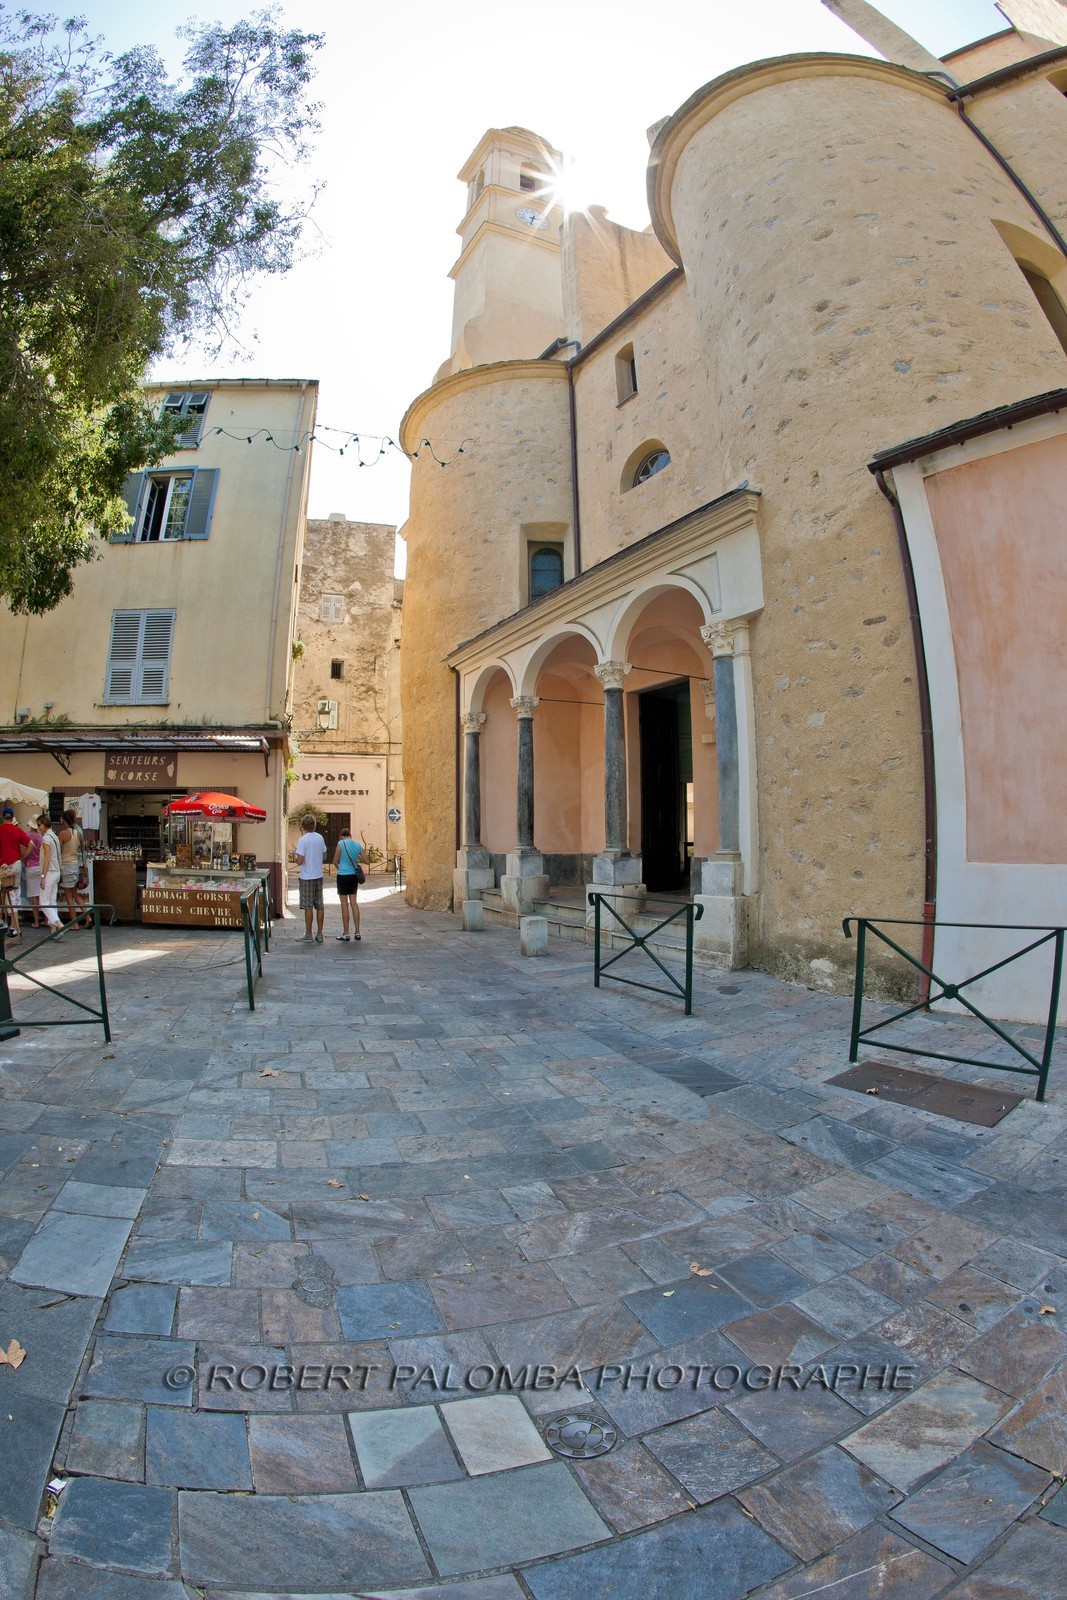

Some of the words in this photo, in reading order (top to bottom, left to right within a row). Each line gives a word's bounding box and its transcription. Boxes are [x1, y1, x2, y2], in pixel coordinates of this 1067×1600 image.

[109, 755, 166, 766] SENTEURS
[120, 771, 158, 781] CORSE
[142, 889, 189, 900] FROMAGE
[196, 892, 231, 902] CORSE
[142, 904, 182, 914] BREBIS
[189, 906, 231, 917] CHEVRE
